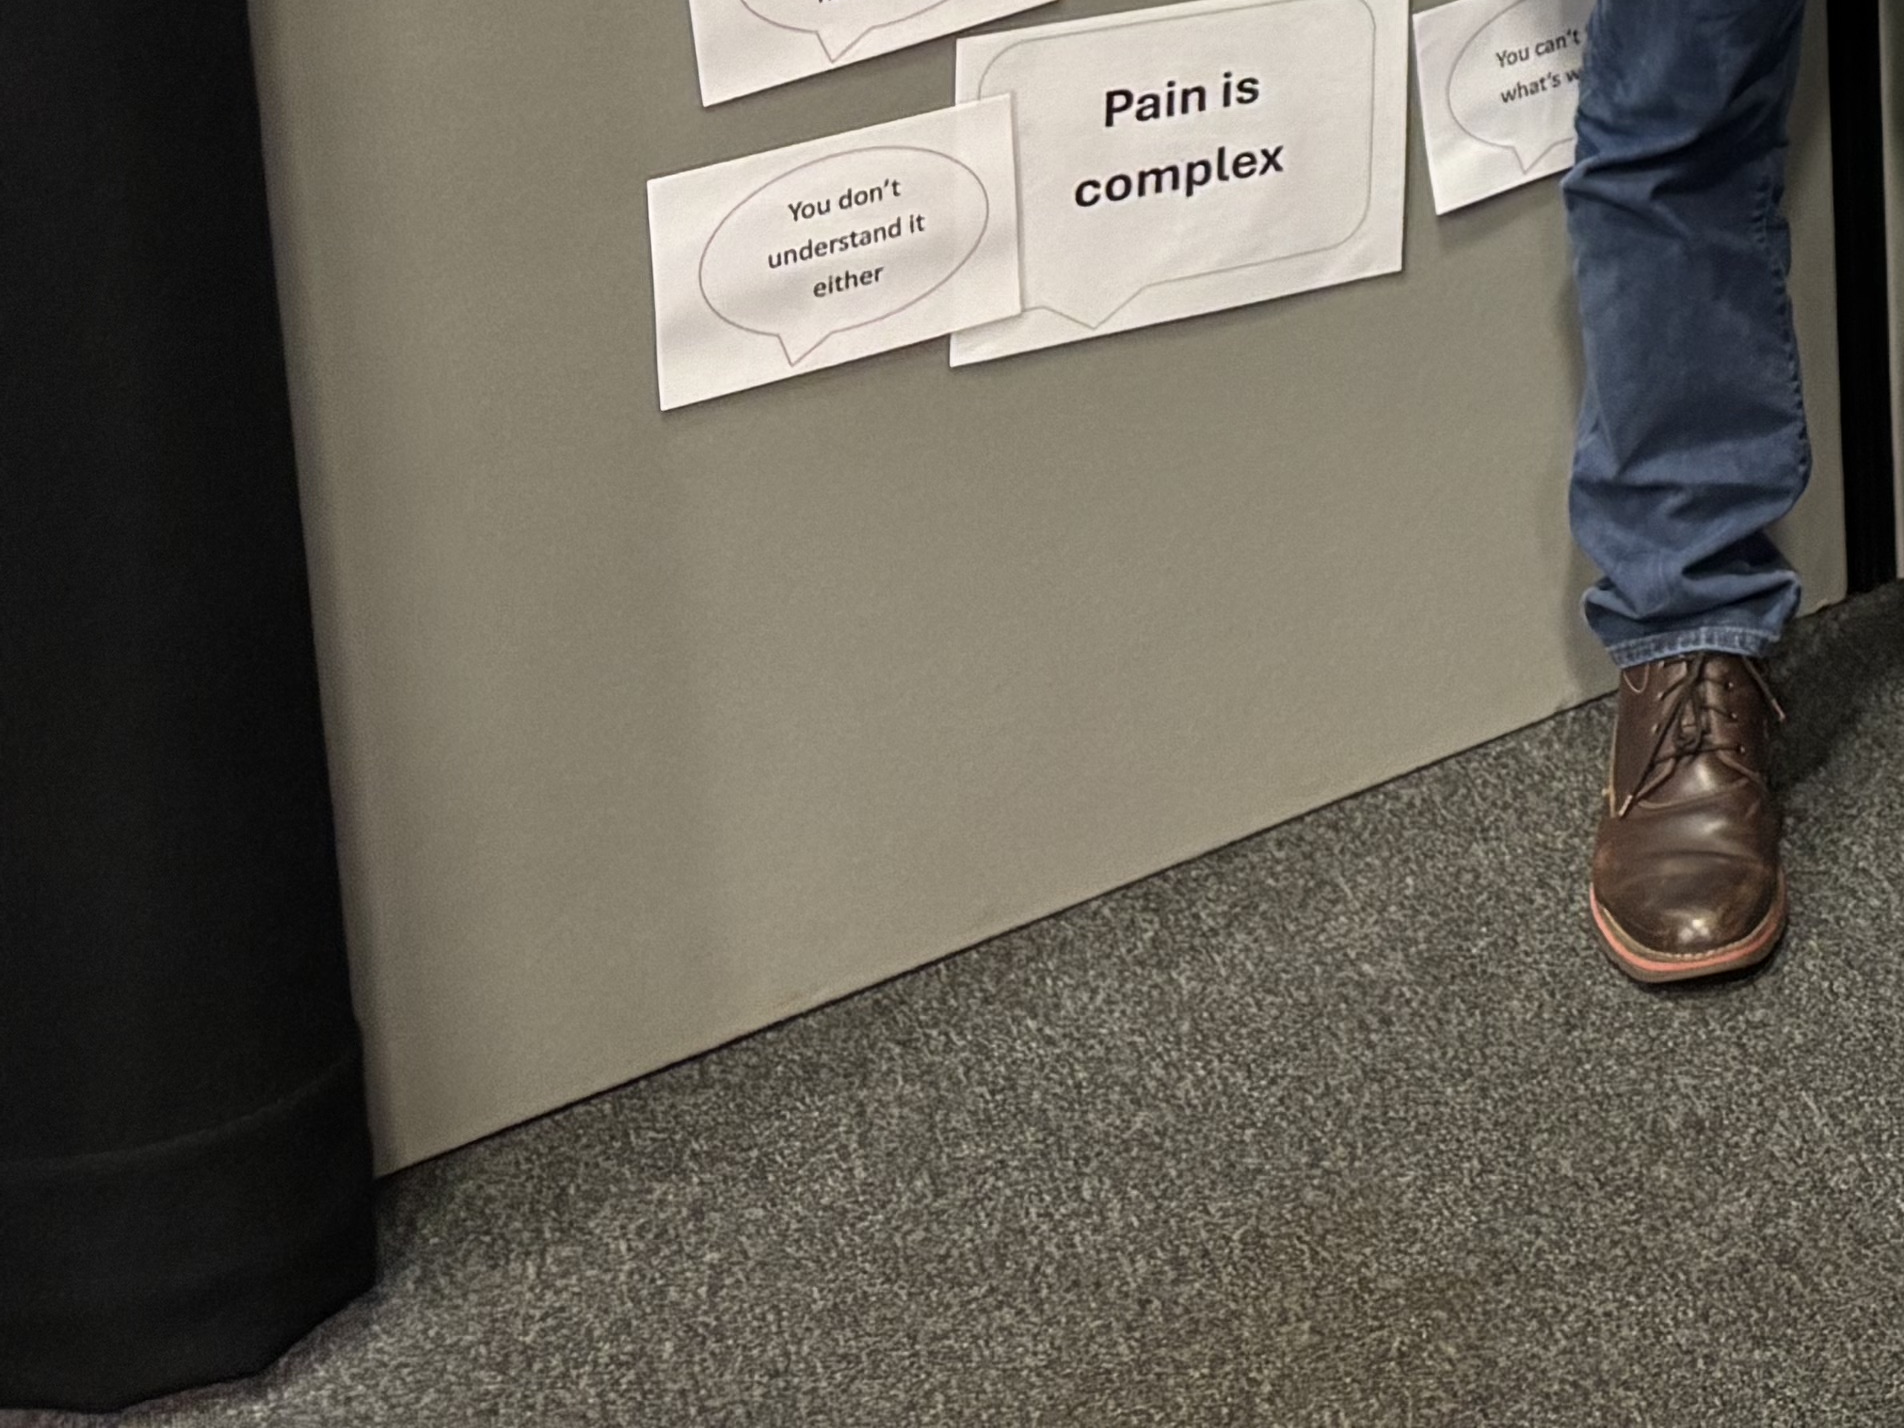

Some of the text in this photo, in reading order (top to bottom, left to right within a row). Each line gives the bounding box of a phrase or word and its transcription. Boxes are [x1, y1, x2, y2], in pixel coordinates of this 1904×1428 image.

[1105, 72, 1258, 127] Pain is
[1075, 146, 1283, 207] complex
